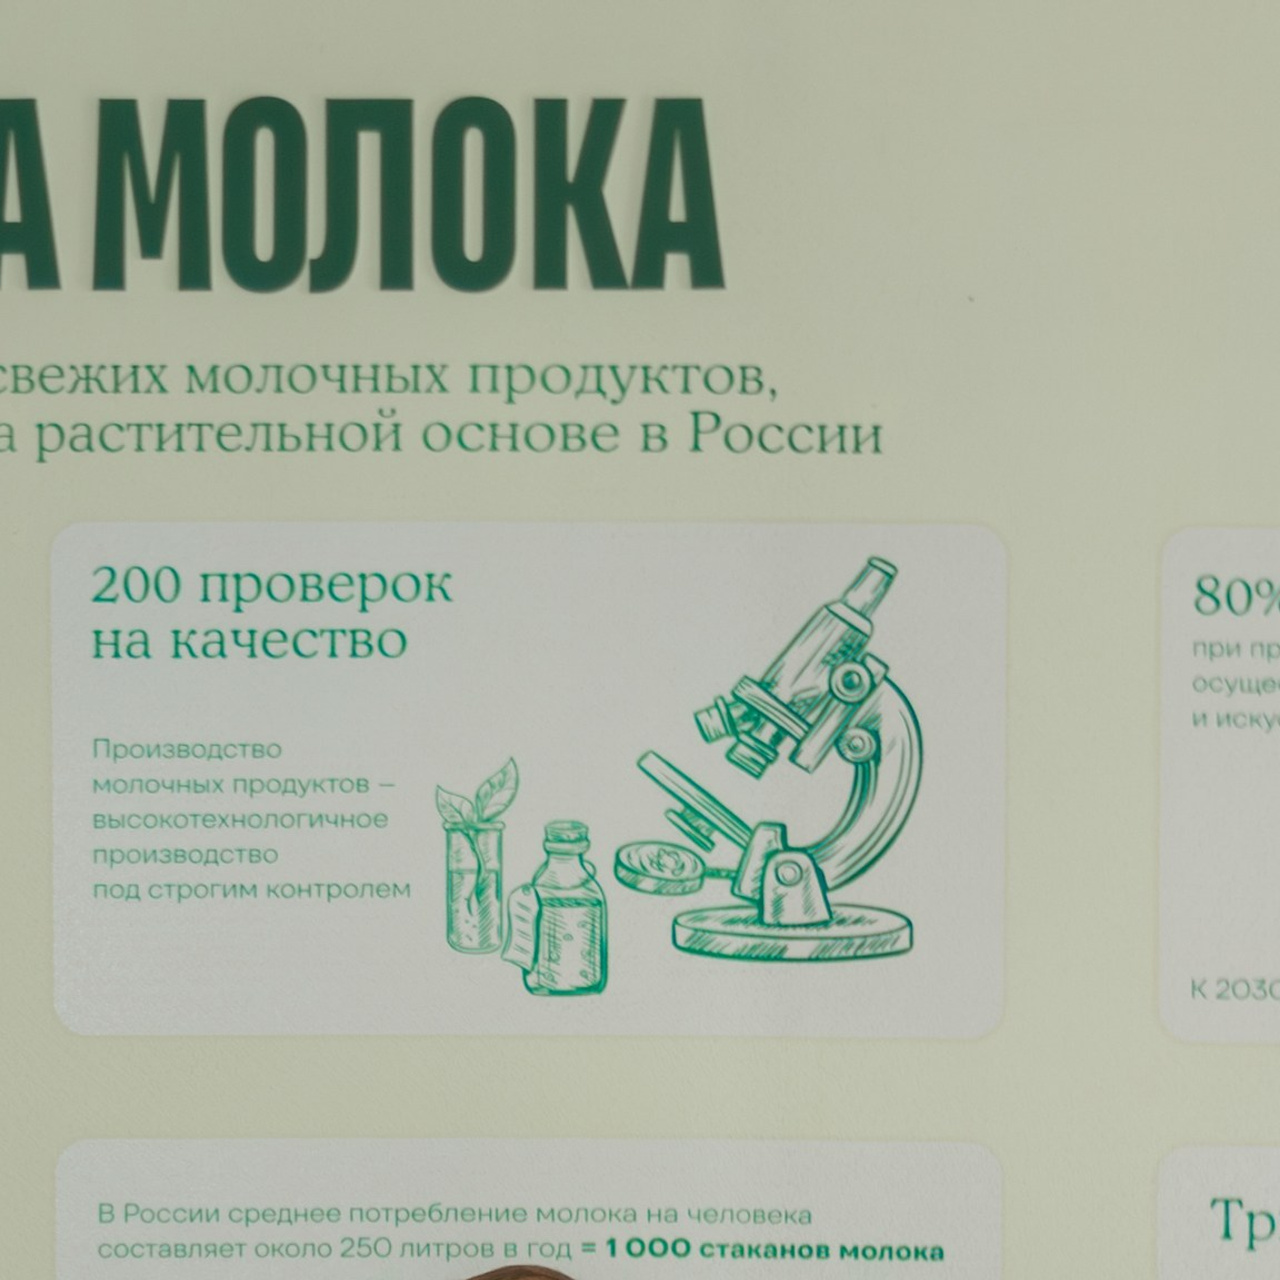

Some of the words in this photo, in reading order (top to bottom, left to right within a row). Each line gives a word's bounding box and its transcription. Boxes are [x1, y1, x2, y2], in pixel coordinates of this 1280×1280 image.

[92, 95, 725, 293] МОЛОКА
[185, 361, 450, 395] молочных
[468, 362, 778, 407] продуктов,
[34, 407, 403, 465] растительной
[420, 420, 621, 454] основе
[640, 421, 670, 454] в
[688, 408, 883, 456] России
[89, 564, 183, 605] 200
[198, 570, 454, 615] проверок
[91, 627, 154, 661] на
[169, 626, 409, 661] качество
[1192, 640, 1242, 662] при
[1192, 675, 1280, 697] осуще
[1192, 711, 1208, 728] и
[1216, 711, 1280, 734] иску
[92, 737, 283, 764] Производство
[91, 777, 224, 795] молочных
[232, 776, 371, 799] продуктов
[92, 811, 389, 830] высокотехнологичное
[92, 847, 279, 870] производство
[92, 882, 143, 902] под
[147, 882, 259, 904] строгим
[265, 881, 412, 904] контролем
[1191, 977, 1208, 1000] К
[97, 1201, 116, 1225] В
[123, 1202, 221, 1225] России
[227, 1206, 342, 1228] среднее
[348, 1201, 528, 1228] потребление
[535, 1206, 638, 1224] молока
[645, 1207, 679, 1224] на
[686, 1207, 813, 1226] человека
[97, 1241, 247, 1260] составляет
[253, 1242, 333, 1259] около
[339, 1236, 393, 1259] 250
[399, 1241, 495, 1263] литров
[503, 1242, 519, 1259] в
[526, 1242, 573, 1264] год
[698, 1240, 832, 1262] стаканов
[837, 1243, 946, 1264] молока
